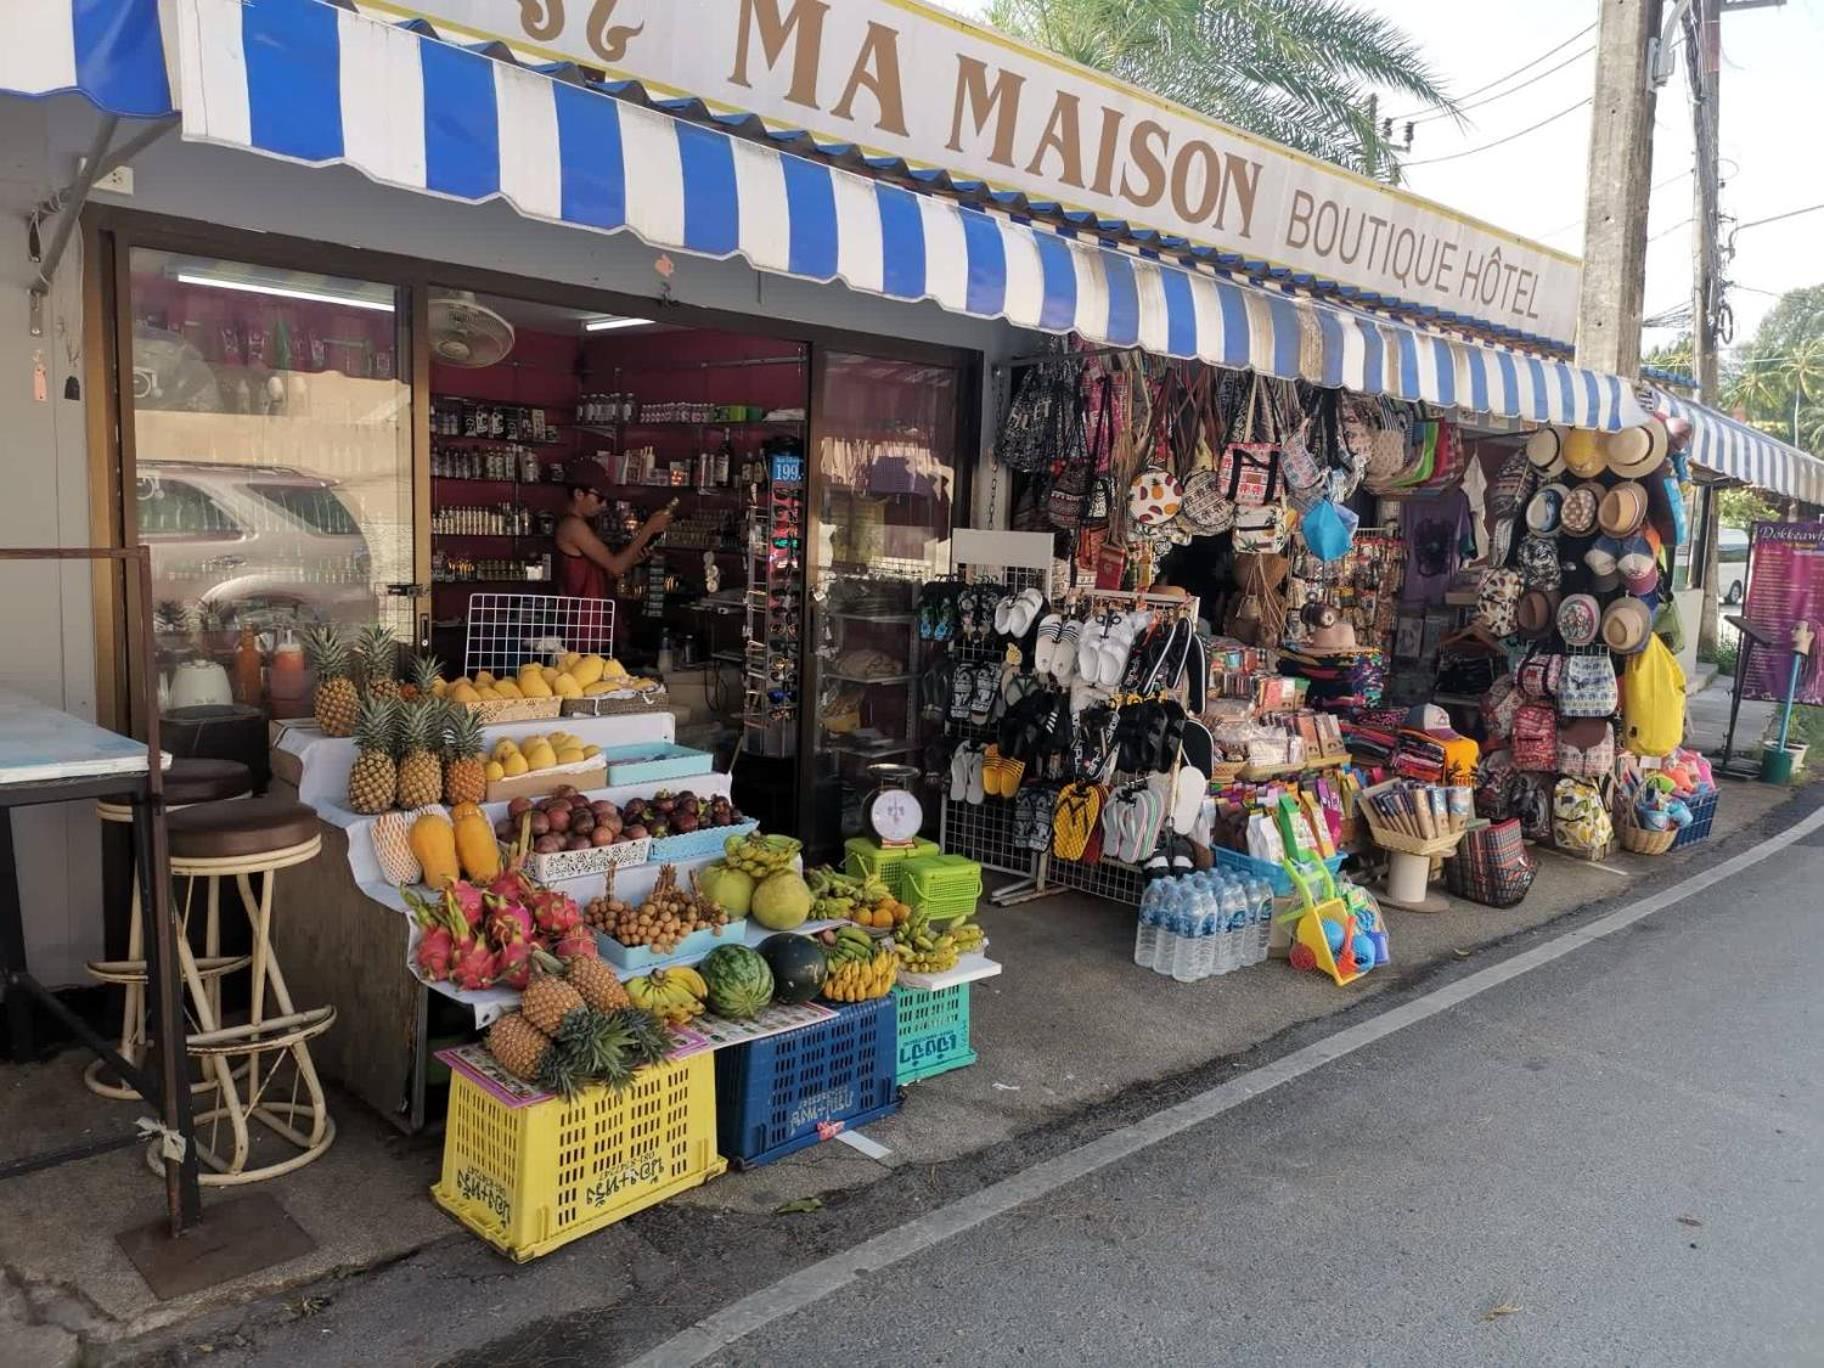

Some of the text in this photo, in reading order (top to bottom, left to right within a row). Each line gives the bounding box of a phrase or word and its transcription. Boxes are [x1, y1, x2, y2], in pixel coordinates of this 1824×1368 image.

[727, 0, 1539, 319] MA MAISON BOUTIQUE HÔTEL
